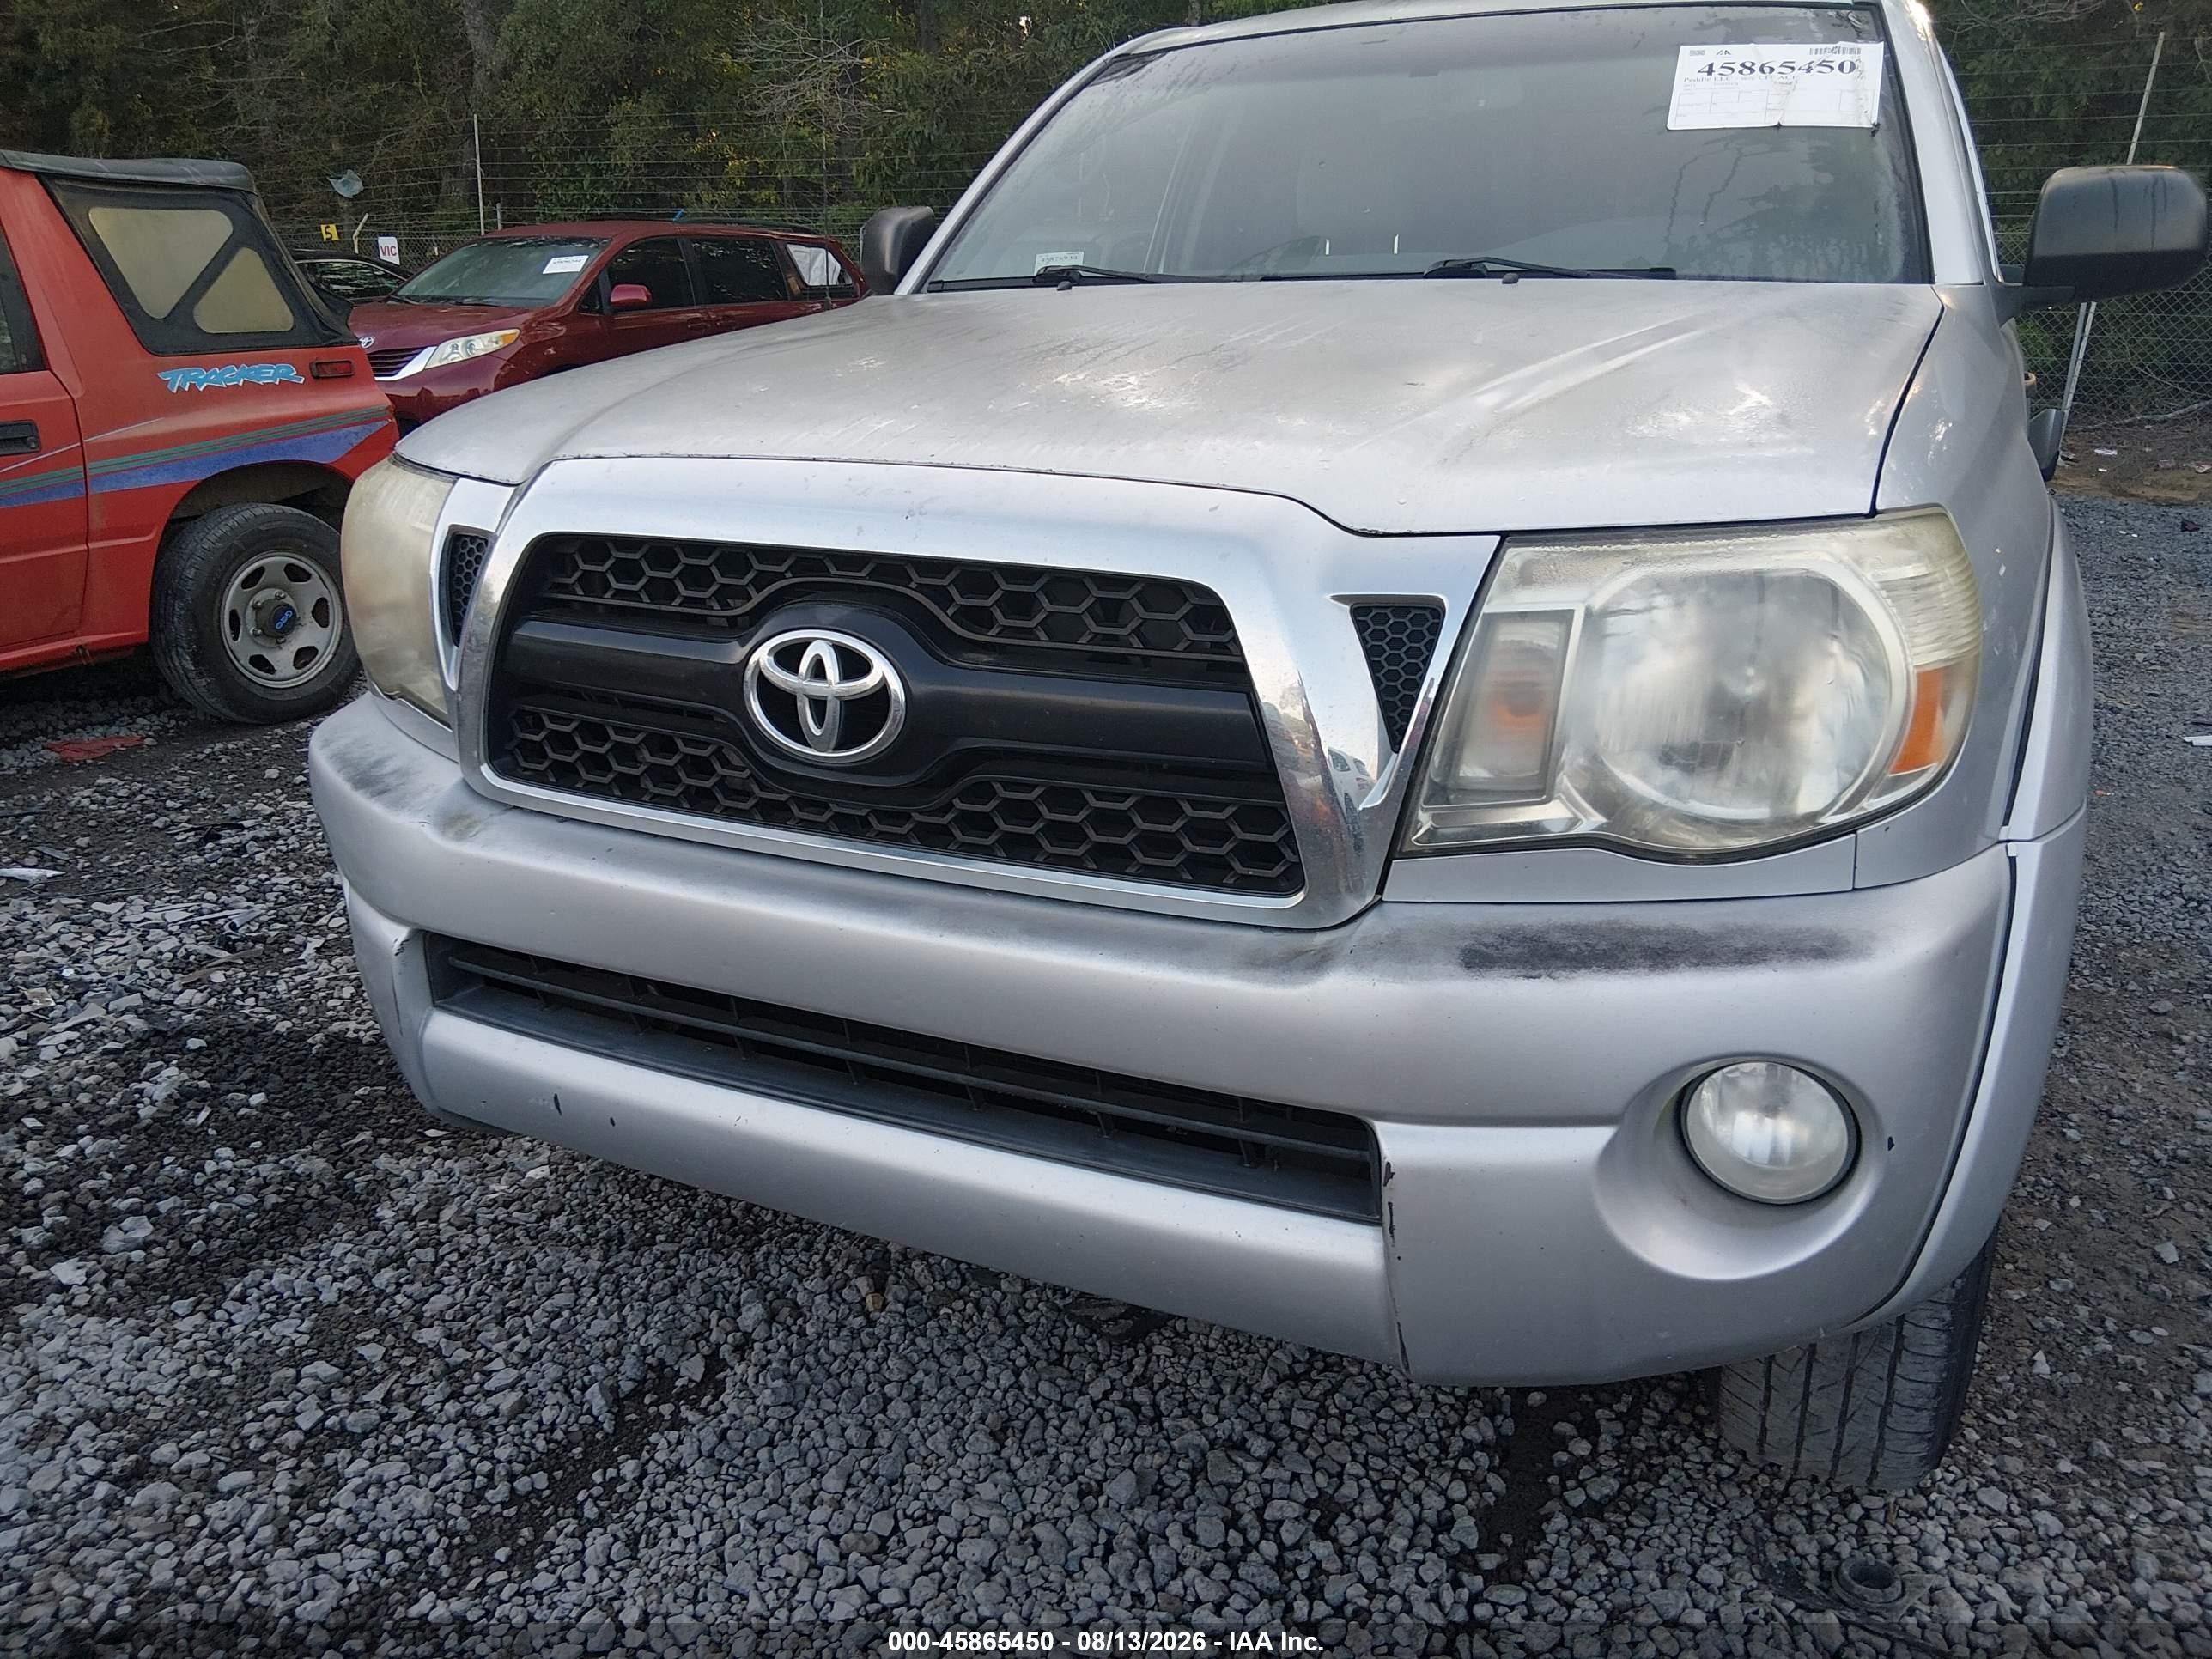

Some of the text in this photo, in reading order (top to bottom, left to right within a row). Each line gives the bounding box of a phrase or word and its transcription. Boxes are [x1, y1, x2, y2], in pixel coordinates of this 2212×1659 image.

[1698, 60, 1856, 76] 45865450
[325, 225, 333, 240] 5
[380, 246, 397, 257] VIC
[157, 363, 305, 393] TRACKER
